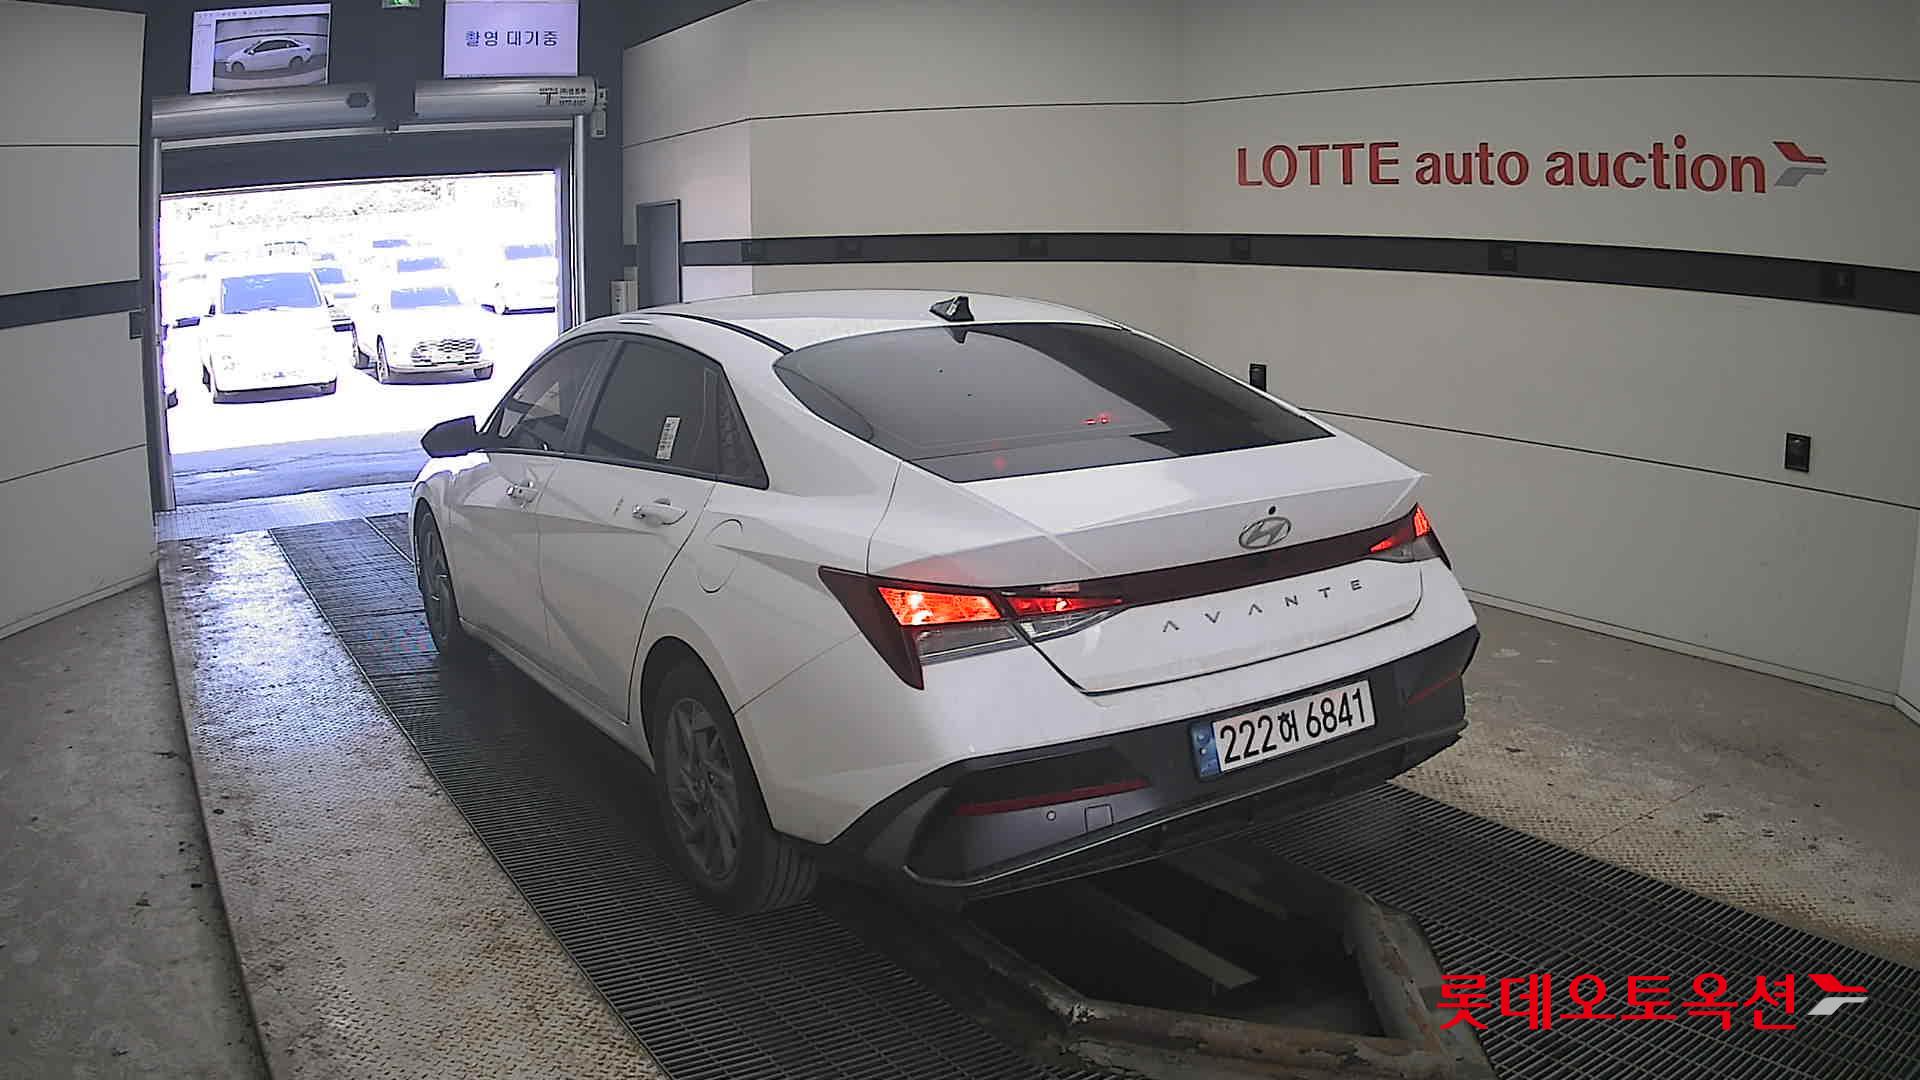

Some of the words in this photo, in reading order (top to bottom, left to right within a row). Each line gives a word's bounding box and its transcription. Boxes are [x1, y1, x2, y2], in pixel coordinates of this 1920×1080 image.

[506, 31, 557, 47] 대기중
[1236, 143, 1399, 189] LOTTE
[1415, 143, 1530, 187] auto
[1546, 134, 1767, 194] auction
[1162, 579, 1363, 632] AVANTE
[1220, 709, 1299, 765] 222허
[1306, 688, 1365, 739] 6841
